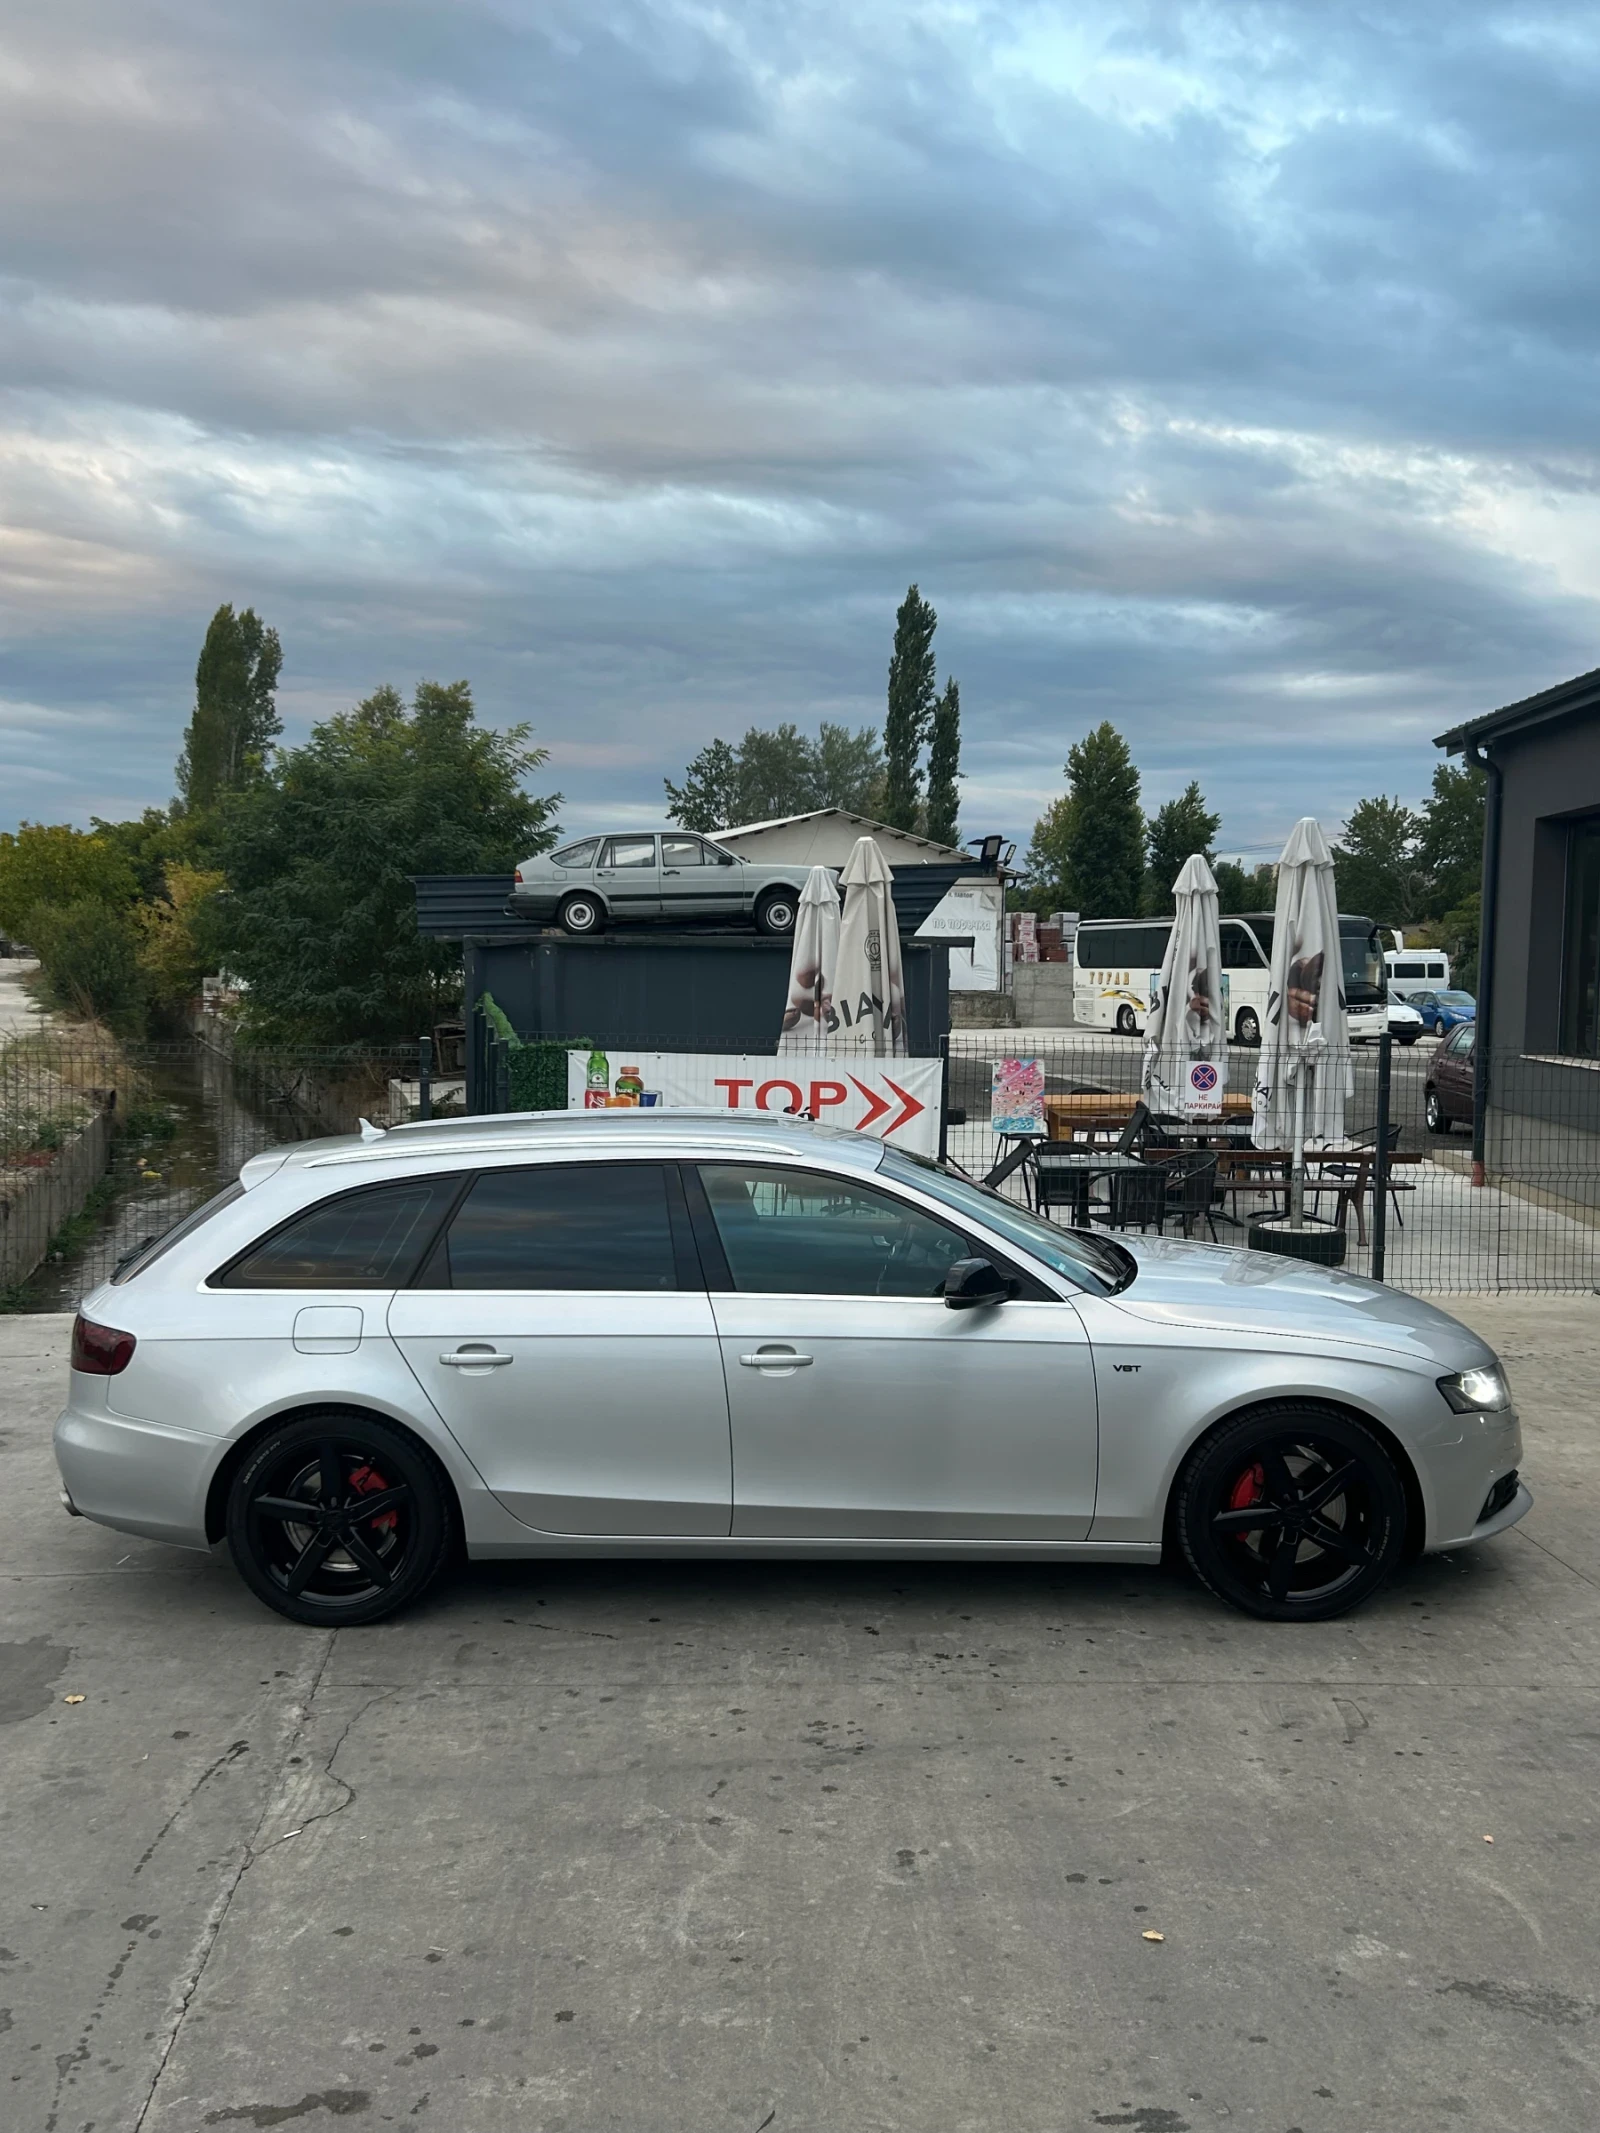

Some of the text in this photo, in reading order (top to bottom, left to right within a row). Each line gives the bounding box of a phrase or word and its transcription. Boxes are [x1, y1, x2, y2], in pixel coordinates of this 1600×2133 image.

[714, 1078, 848, 1120] TOP
[1198, 1093, 1209, 1101] НЕ
[1184, 1101, 1222, 1110] ПАРКИРАЙ
